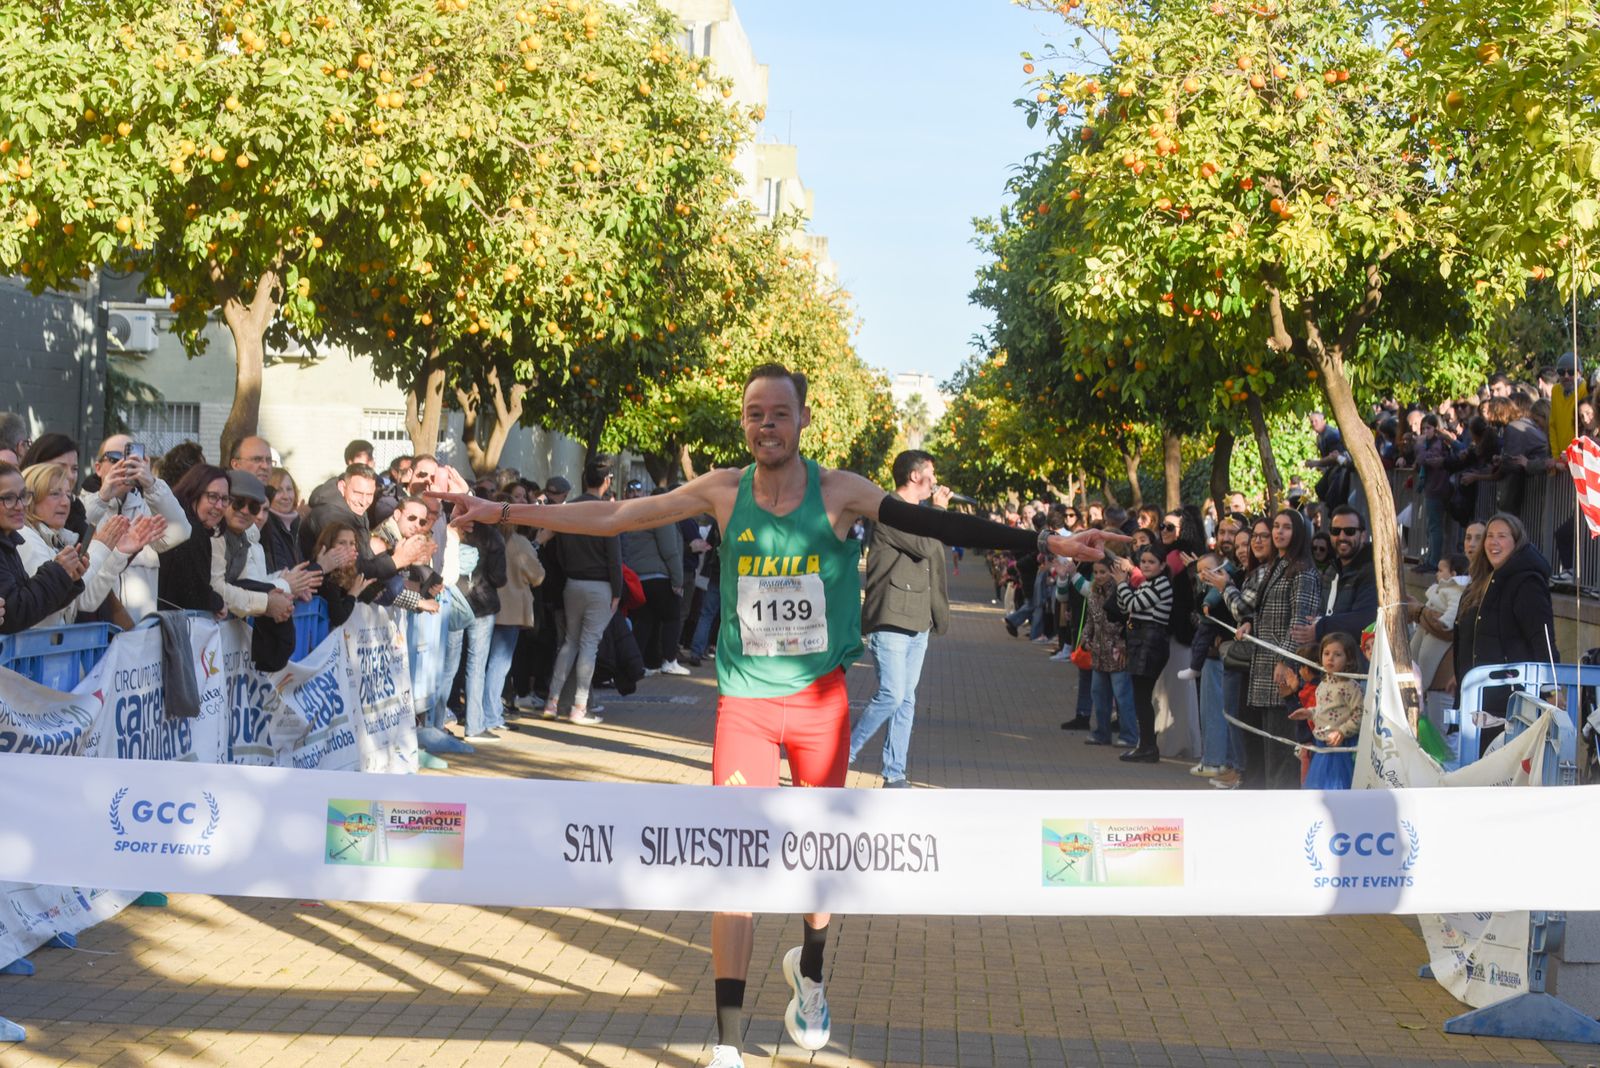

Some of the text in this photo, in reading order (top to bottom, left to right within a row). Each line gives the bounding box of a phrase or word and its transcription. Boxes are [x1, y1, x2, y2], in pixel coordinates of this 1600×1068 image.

[738, 555, 820, 576] BIKILA
[752, 599, 812, 621] 1139
[132, 800, 196, 824] GCC
[390, 815, 461, 826] EL PARQUE
[114, 840, 211, 855] SPORT EVENTS
[563, 823, 940, 873] SAN SILVESTRE CORDOBESA
[1107, 833, 1180, 842] EL PARQUE
[1329, 832, 1396, 857] GCC
[1314, 876, 1414, 888] SPORT EVENTS
